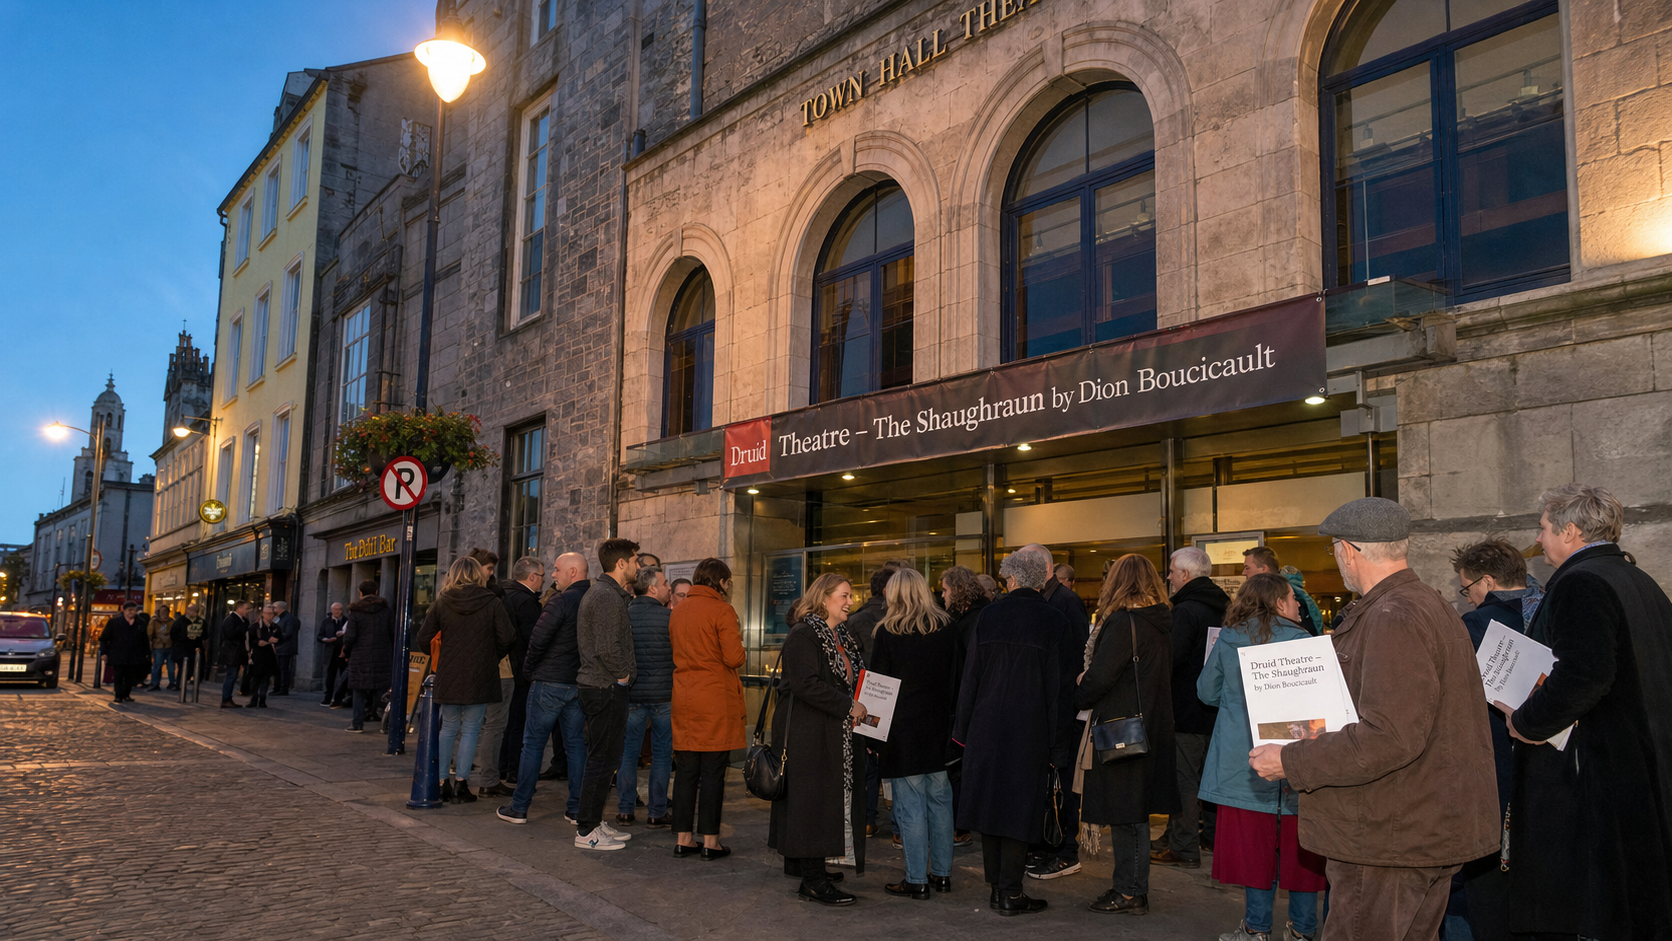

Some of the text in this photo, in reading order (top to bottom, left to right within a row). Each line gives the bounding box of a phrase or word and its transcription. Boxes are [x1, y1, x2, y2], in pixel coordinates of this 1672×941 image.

[800, 70, 866, 127] TOWN
[879, 28, 948, 87] HALL
[730, 439, 767, 467] Druid
[779, 427, 850, 457] Theatre
[873, 414, 911, 440] The
[916, 391, 1045, 434] Shaughraun
[1051, 386, 1075, 413] by
[1078, 377, 1130, 404] Dion
[1137, 343, 1276, 394] Boucicault
[379, 534, 396, 554] Bar
[1250, 659, 1277, 670] Druid
[1278, 655, 1314, 666] Theatre
[1252, 671, 1270, 680] The
[1254, 684, 1263, 693] by
